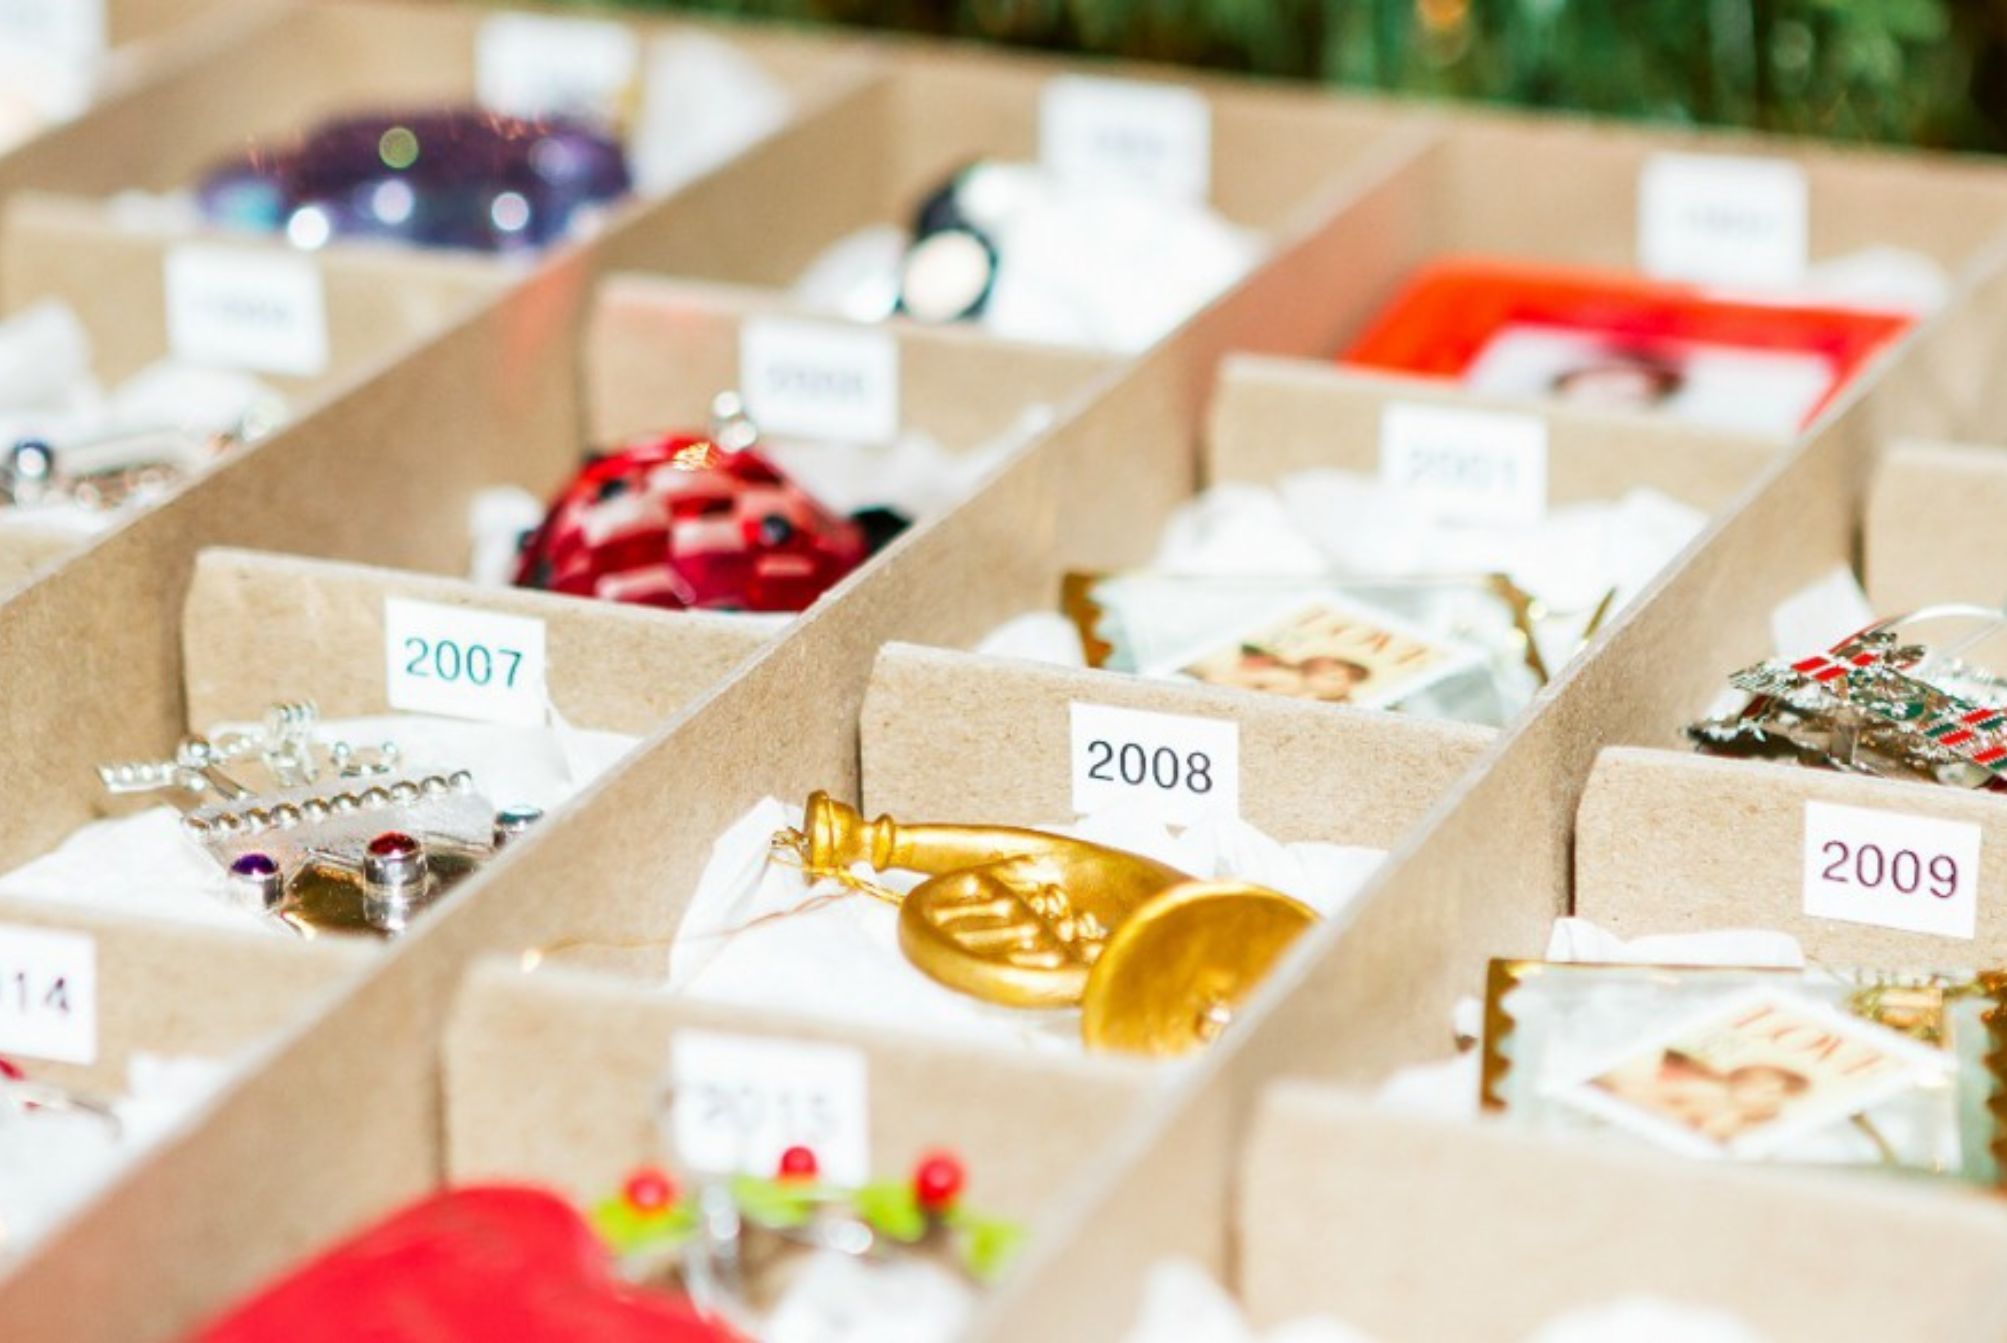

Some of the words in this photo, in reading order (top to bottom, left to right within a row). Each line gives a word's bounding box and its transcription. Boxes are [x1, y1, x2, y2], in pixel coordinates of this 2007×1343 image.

[404, 636, 523, 688] 2007
[1087, 739, 1213, 794] 2008
[1821, 840, 1958, 899] 2009
[0, 969, 71, 1016] 14
